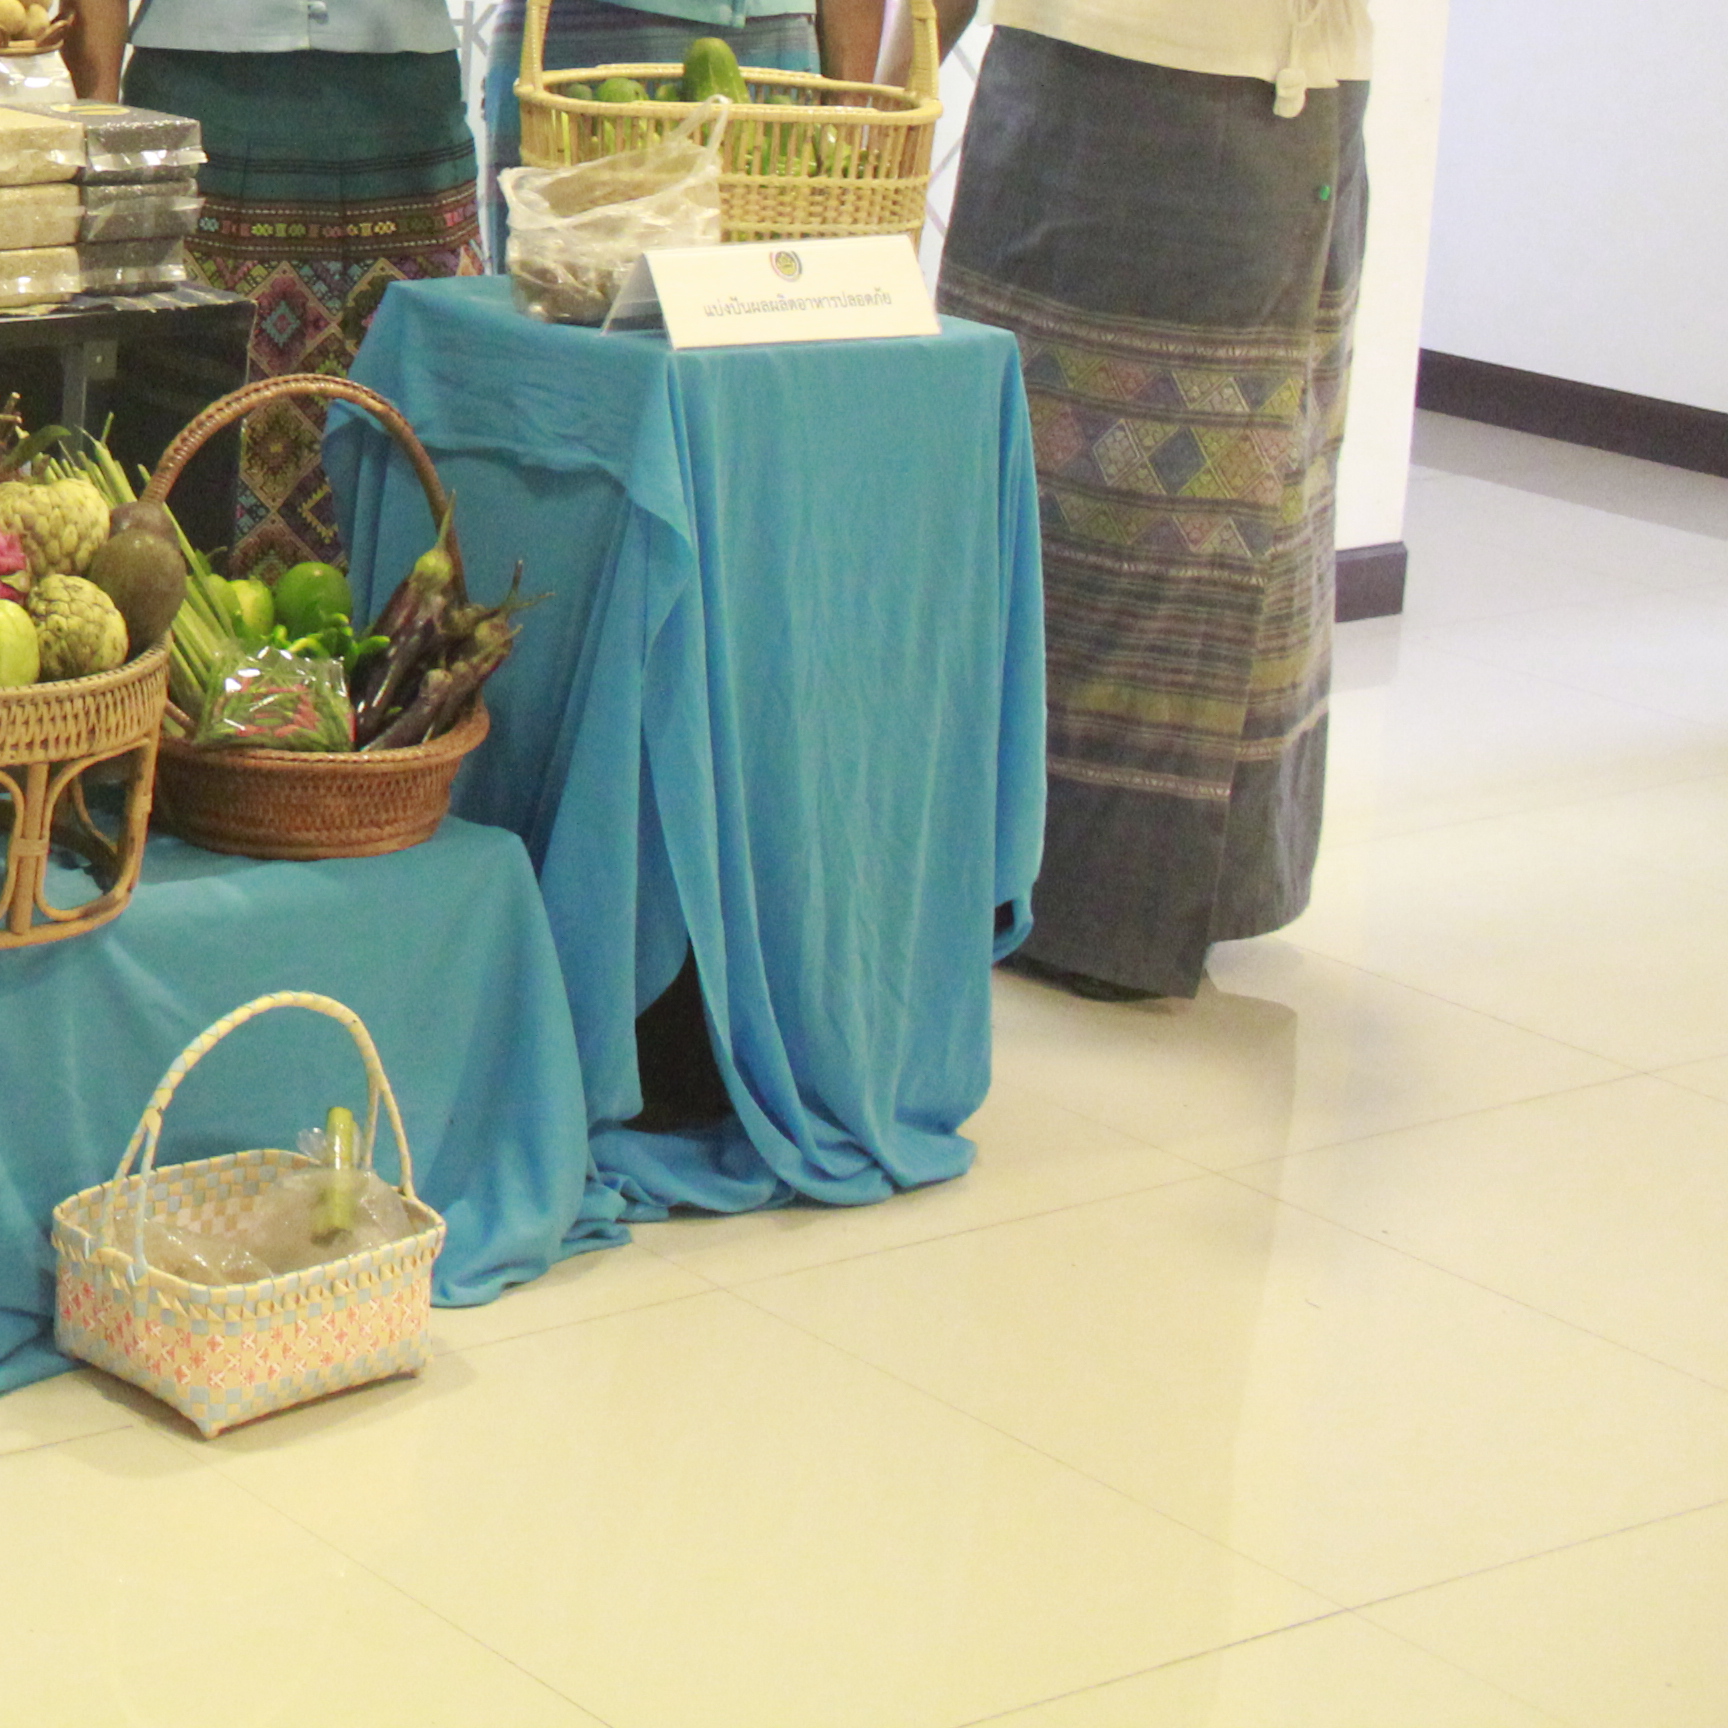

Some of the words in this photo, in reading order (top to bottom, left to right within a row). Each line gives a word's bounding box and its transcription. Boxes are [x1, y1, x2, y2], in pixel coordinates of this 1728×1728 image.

[702, 287, 893, 318] แบ่งปันผลผลิตอาหารปลอดภัย
